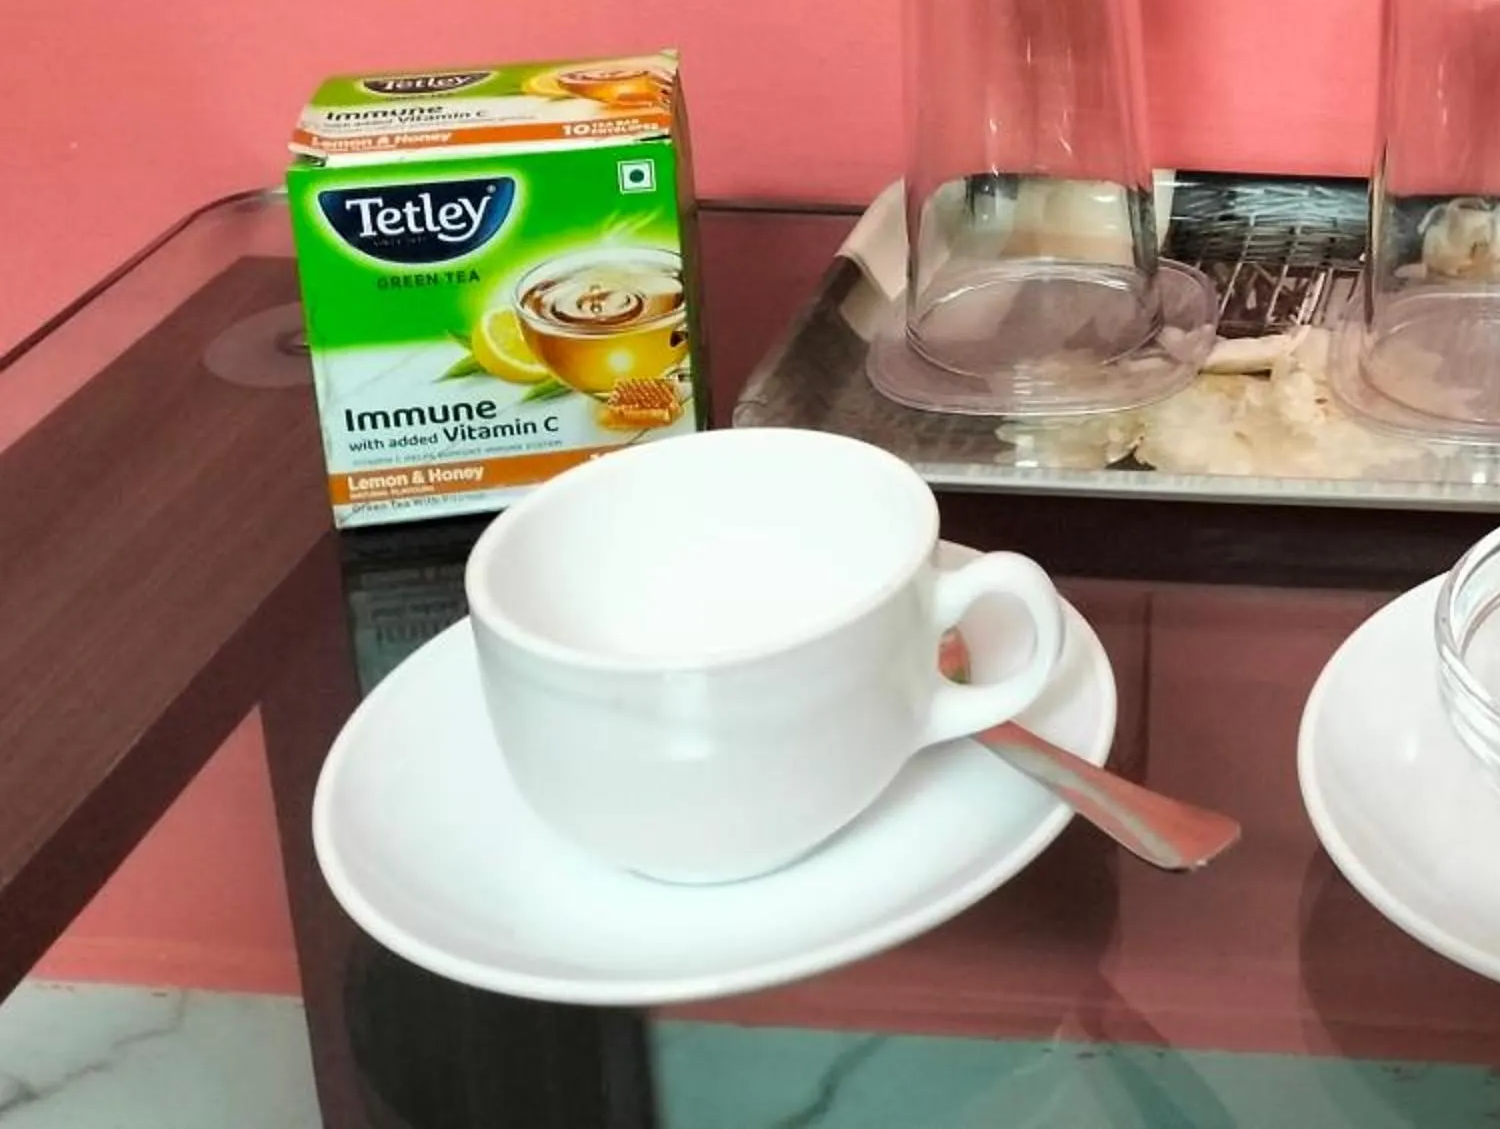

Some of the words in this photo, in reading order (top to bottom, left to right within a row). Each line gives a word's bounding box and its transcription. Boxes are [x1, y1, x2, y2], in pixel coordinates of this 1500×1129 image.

[381, 74, 471, 91] Tetley
[562, 123, 590, 136] 10
[345, 192, 491, 243] Tetley
[377, 273, 438, 290] GREEN
[444, 269, 480, 284] TEA
[345, 400, 497, 432] Immune
[349, 437, 385, 452] with
[389, 432, 439, 448] added
[443, 418, 538, 443] Vitamin
[543, 416, 559, 433] C
[347, 472, 408, 491] Lemon
[412, 469, 425, 485] &
[428, 465, 484, 483] Honey
